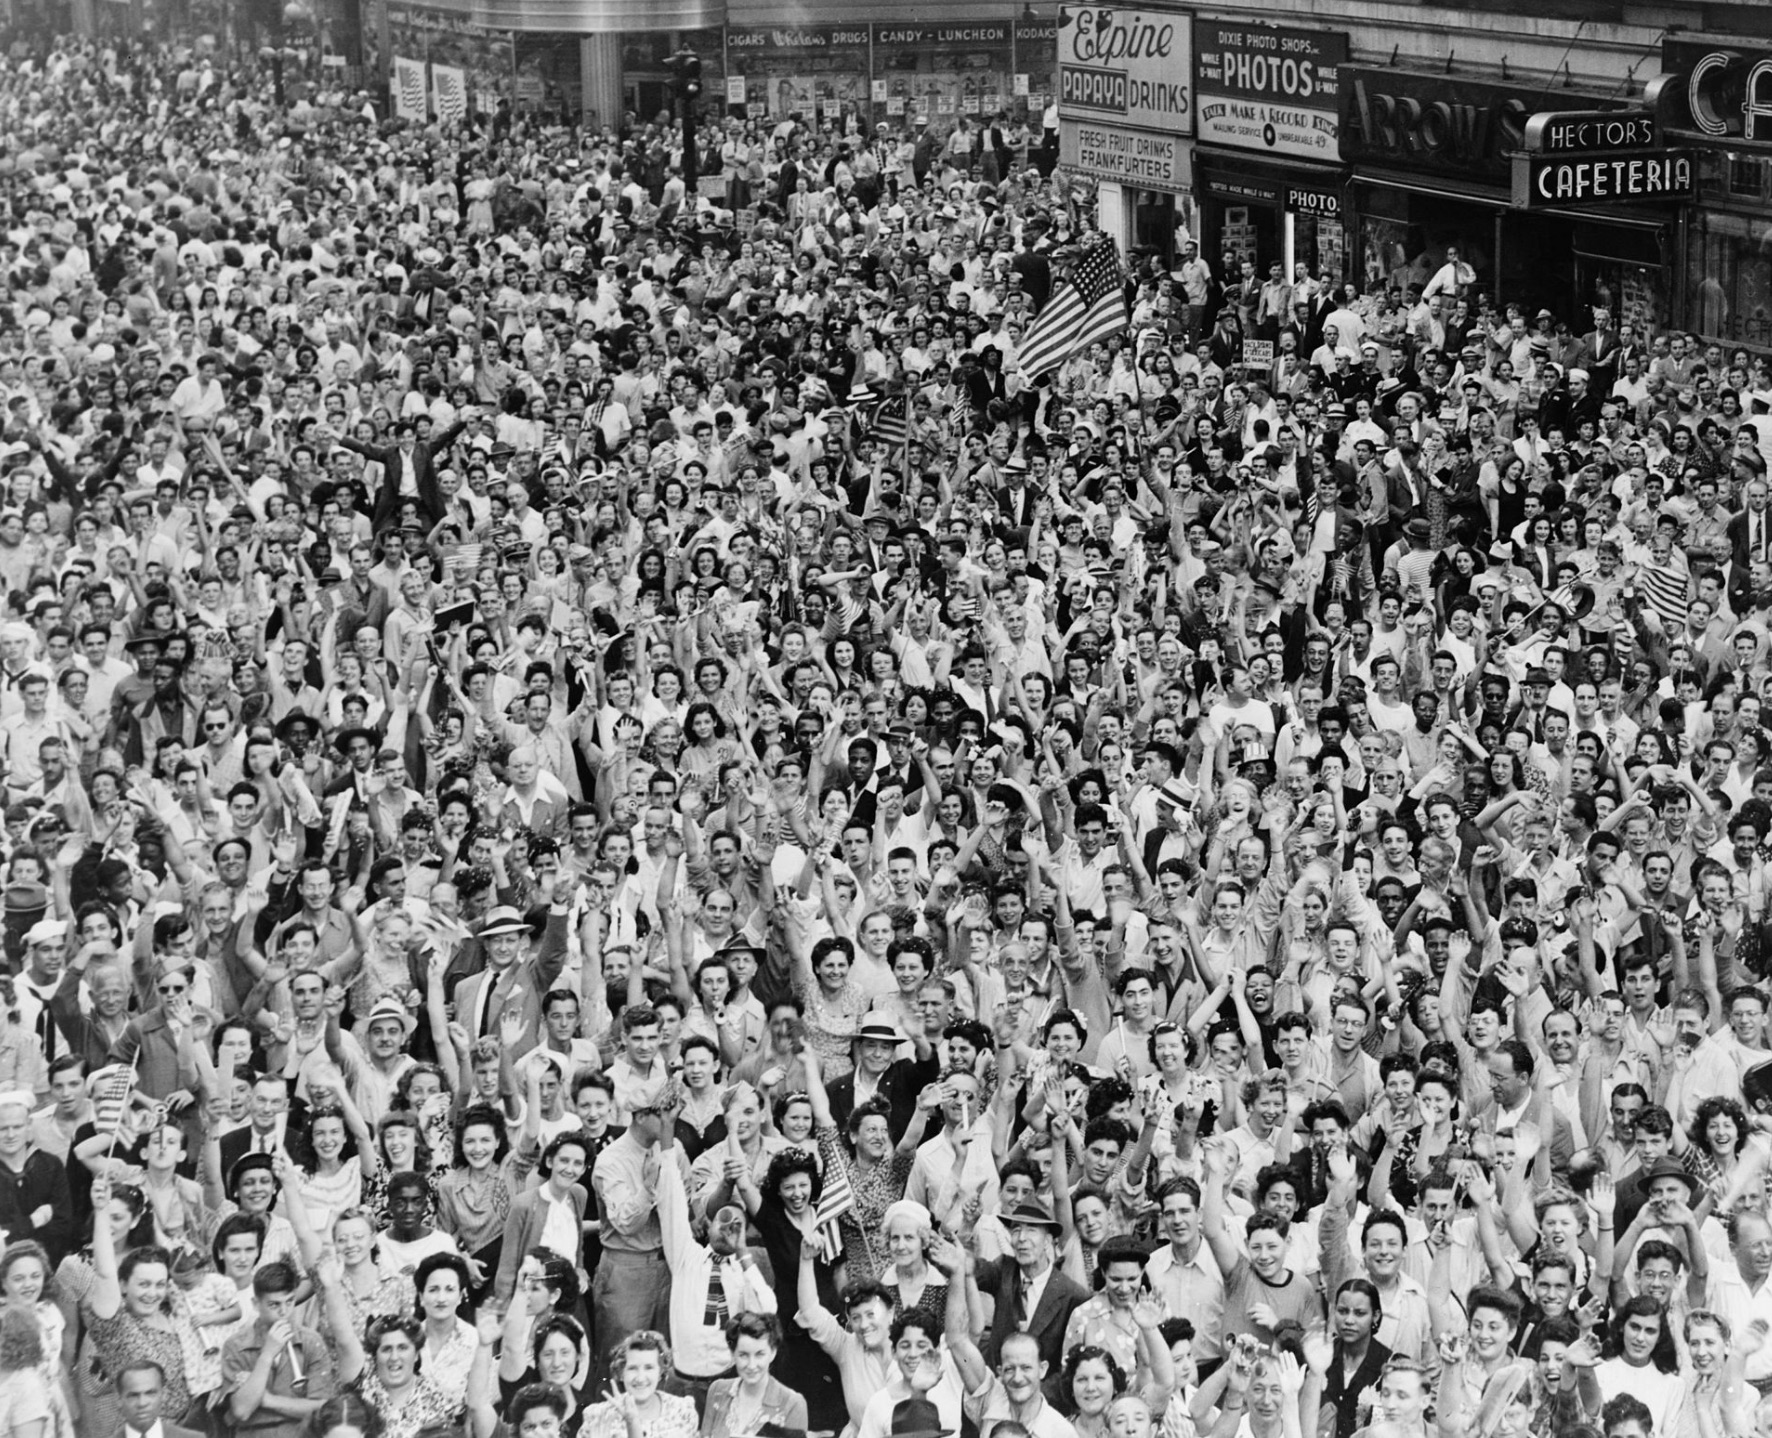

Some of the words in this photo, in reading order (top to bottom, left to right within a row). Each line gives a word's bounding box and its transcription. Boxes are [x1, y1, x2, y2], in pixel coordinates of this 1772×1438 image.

[727, 34, 765, 46] CIGARS
[832, 32, 868, 44] DRUGS
[880, 30, 923, 42] CANDY
[937, 28, 1004, 41] LUNCHEON
[1016, 27, 1057, 39] KODAKS
[1218, 31, 1242, 46] DIXIE
[1246, 34, 1277, 50] PHOTO
[1201, 53, 1220, 65] WHILE
[1224, 52, 1313, 97] PHOTOS
[1317, 66, 1338, 80] WHILE
[1063, 70, 1125, 107] PAPAYA
[1129, 79, 1189, 114] DRINKS
[1229, 102, 1256, 120] MAKE
[1259, 106, 1266, 122] A
[1269, 107, 1308, 128] RECORD
[1238, 126, 1262, 138] SERVICE
[1079, 129, 1106, 148] FRESH
[1109, 133, 1134, 153] FRUIT
[1137, 138, 1173, 159] DRINKS
[1081, 149, 1171, 179] FRANKFURTERS
[1538, 158, 1690, 199] CAFETERIA
